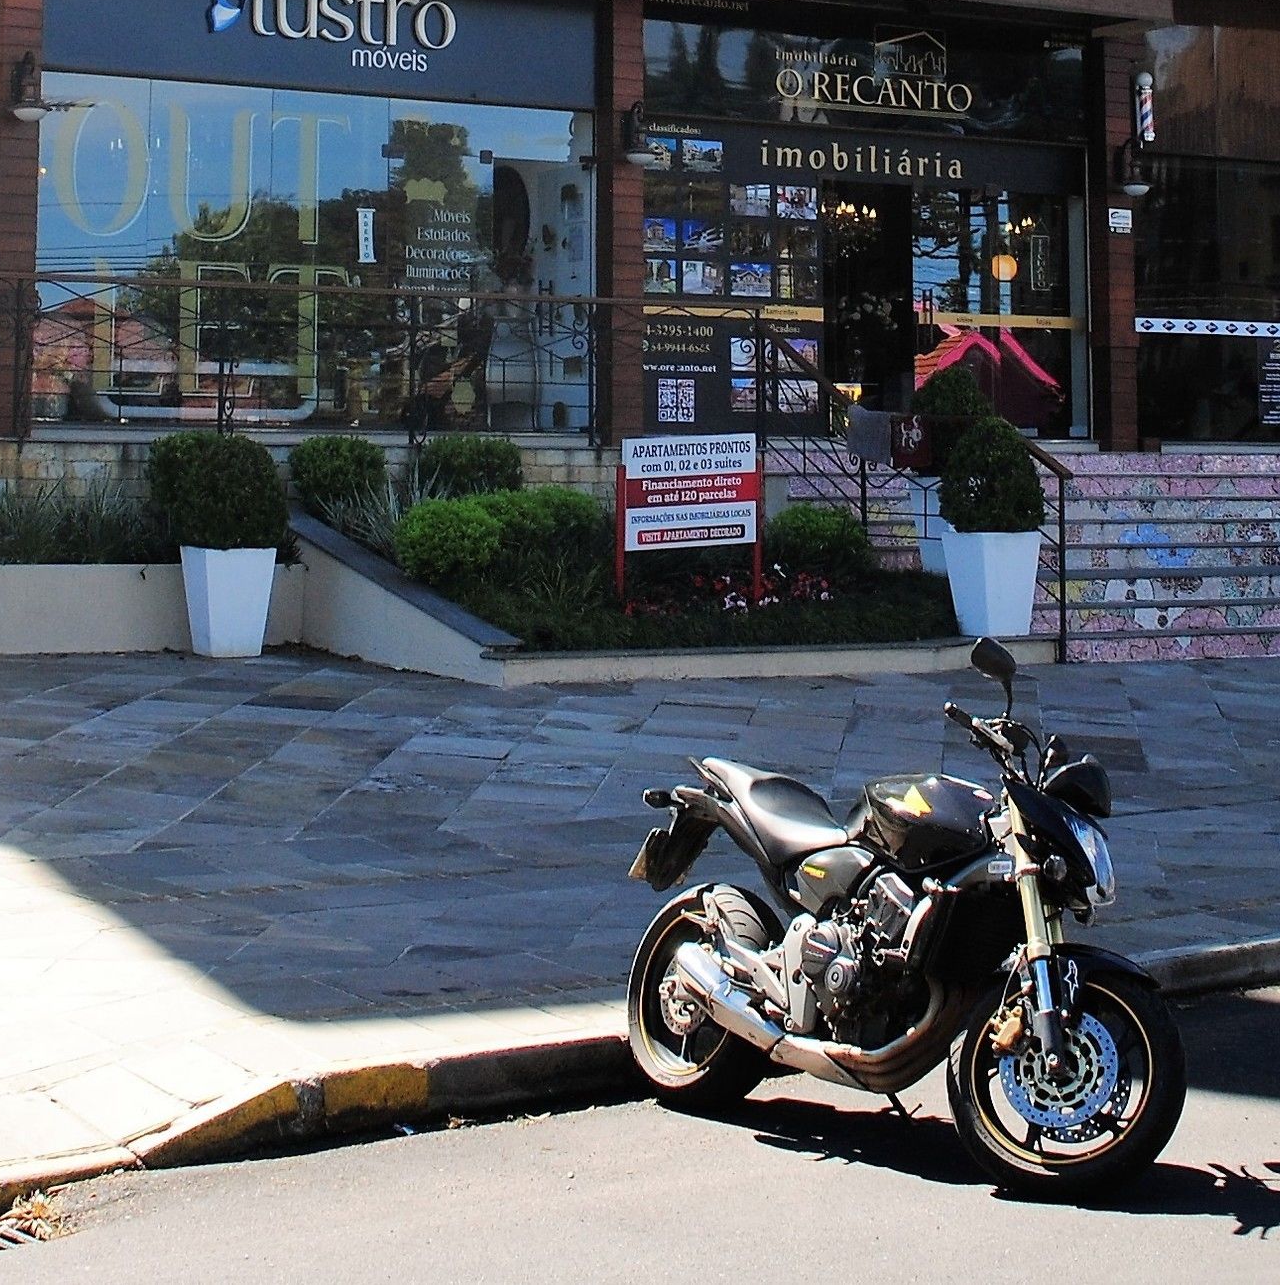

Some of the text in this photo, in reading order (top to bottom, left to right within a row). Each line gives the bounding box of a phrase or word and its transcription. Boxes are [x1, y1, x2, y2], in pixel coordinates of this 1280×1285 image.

[352, 46, 428, 72] móveis
[775, 46, 857, 67] imobiliária
[776, 68, 973, 112] O RECANTO
[760, 139, 963, 179] imobiliária
[433, 209, 471, 224] Móveis
[632, 440, 751, 458] APARTAMENTOS PRONTOS
[641, 456, 742, 473] com 01, 02 e 03 suítes
[642, 476, 742, 491] Financiamento direto
[647, 488, 737, 504] em até 120 parcelas
[730, 508, 752, 518] LOCAIS
